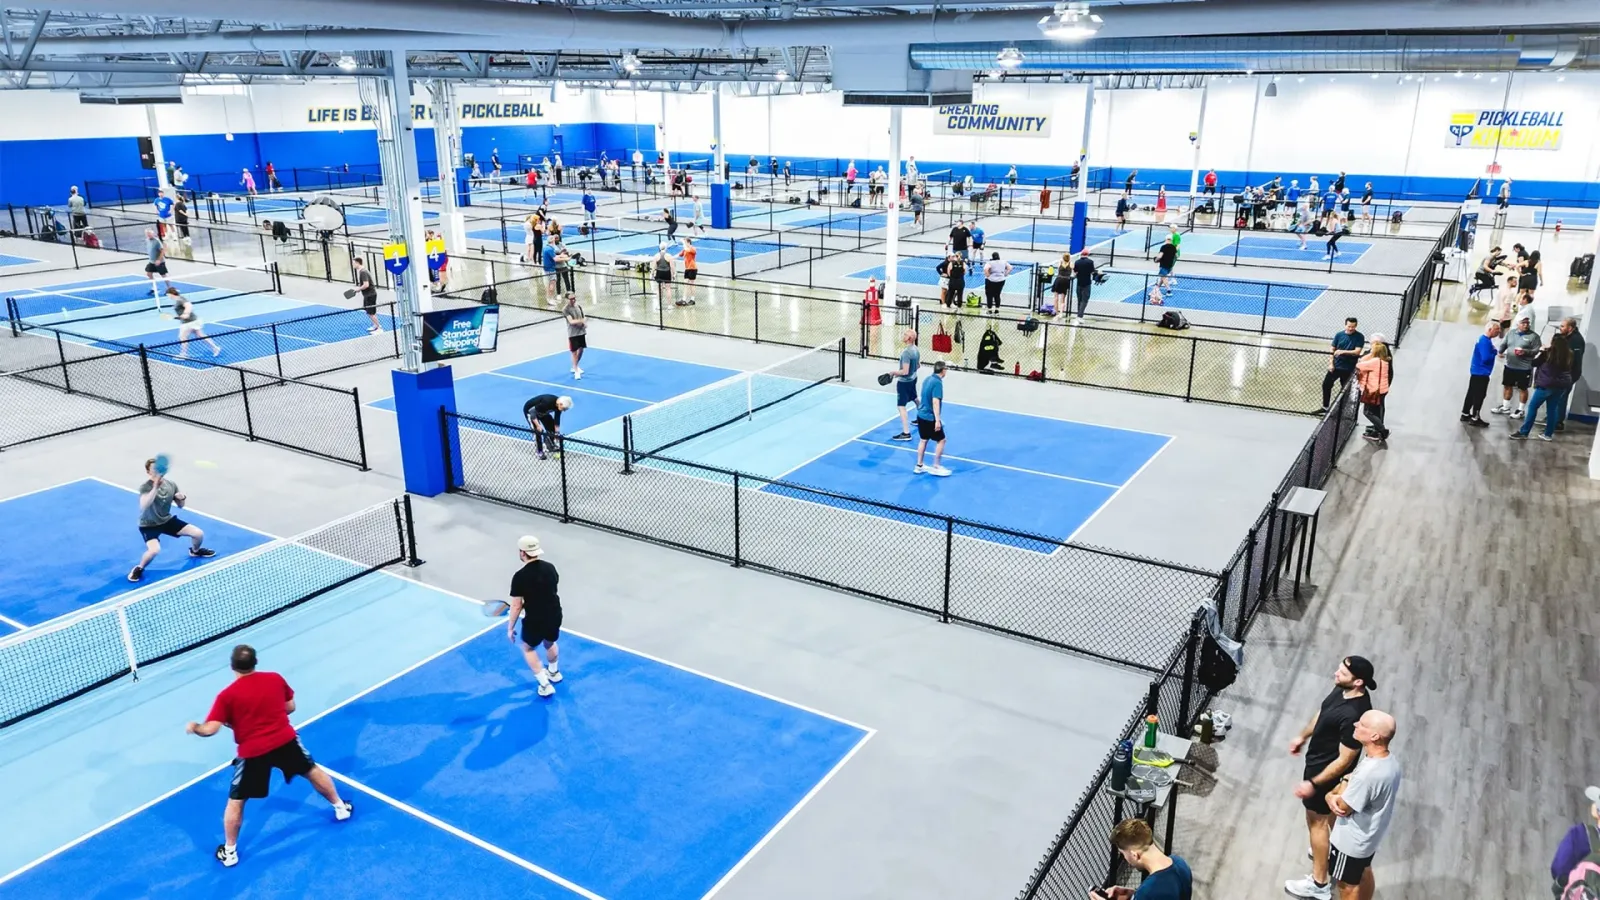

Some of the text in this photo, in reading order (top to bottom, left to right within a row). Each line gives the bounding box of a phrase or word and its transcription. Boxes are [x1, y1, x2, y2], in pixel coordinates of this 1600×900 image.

[308, 109, 340, 122] LIFE
[343, 109, 357, 121] IS
[462, 103, 544, 119] PICKLEBALL
[939, 104, 999, 115] CREATING
[947, 115, 1046, 131] COMMUNITY
[1478, 111, 1564, 127] PICKLEBALL
[392, 251, 402, 267] 1
[429, 246, 439, 262] 4
[442, 325, 481, 340] Standard
[453, 320, 472, 329] Free
[443, 337, 479, 351] Shipping
